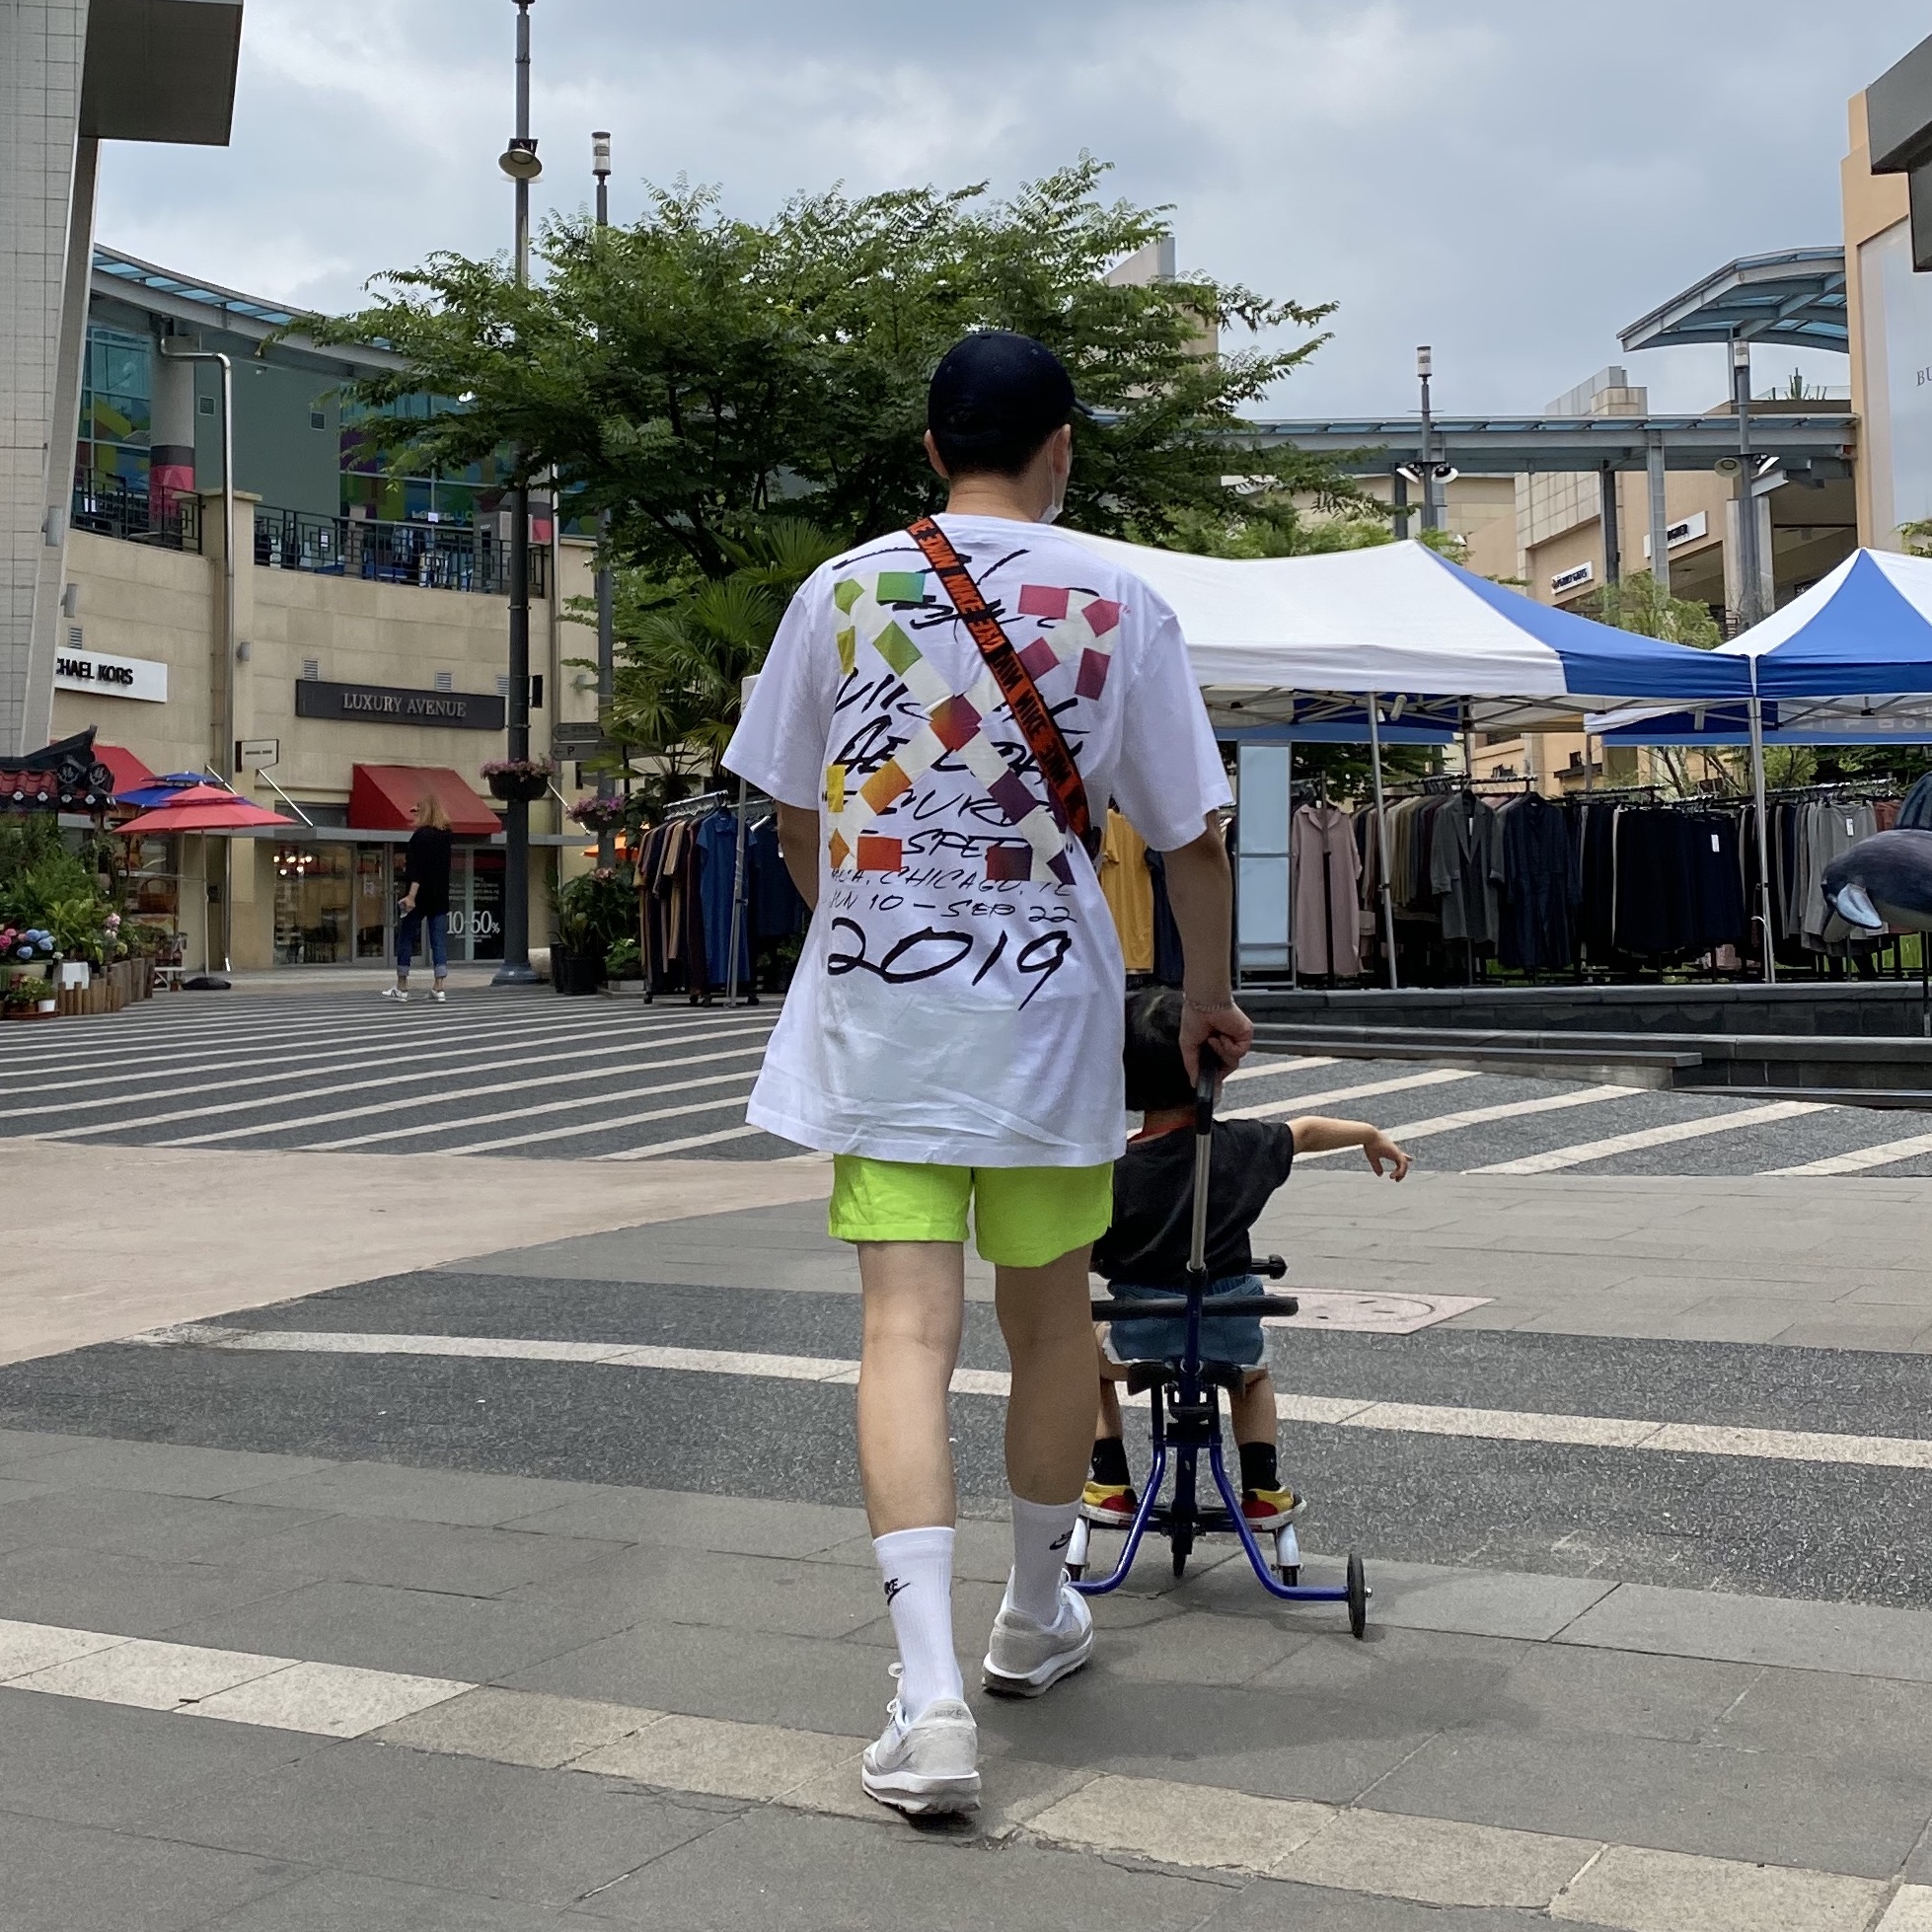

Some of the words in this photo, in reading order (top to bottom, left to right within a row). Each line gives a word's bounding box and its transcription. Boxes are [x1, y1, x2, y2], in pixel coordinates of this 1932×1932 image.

[97, 664, 133, 685] KORS
[343, 693, 403, 712] LUXURY
[408, 699, 467, 716] AVENUE
[869, 894, 904, 912] 10
[940, 899, 1016, 919] SEP
[1028, 906, 1077, 924] 22
[828, 917, 1073, 1011] 2019
